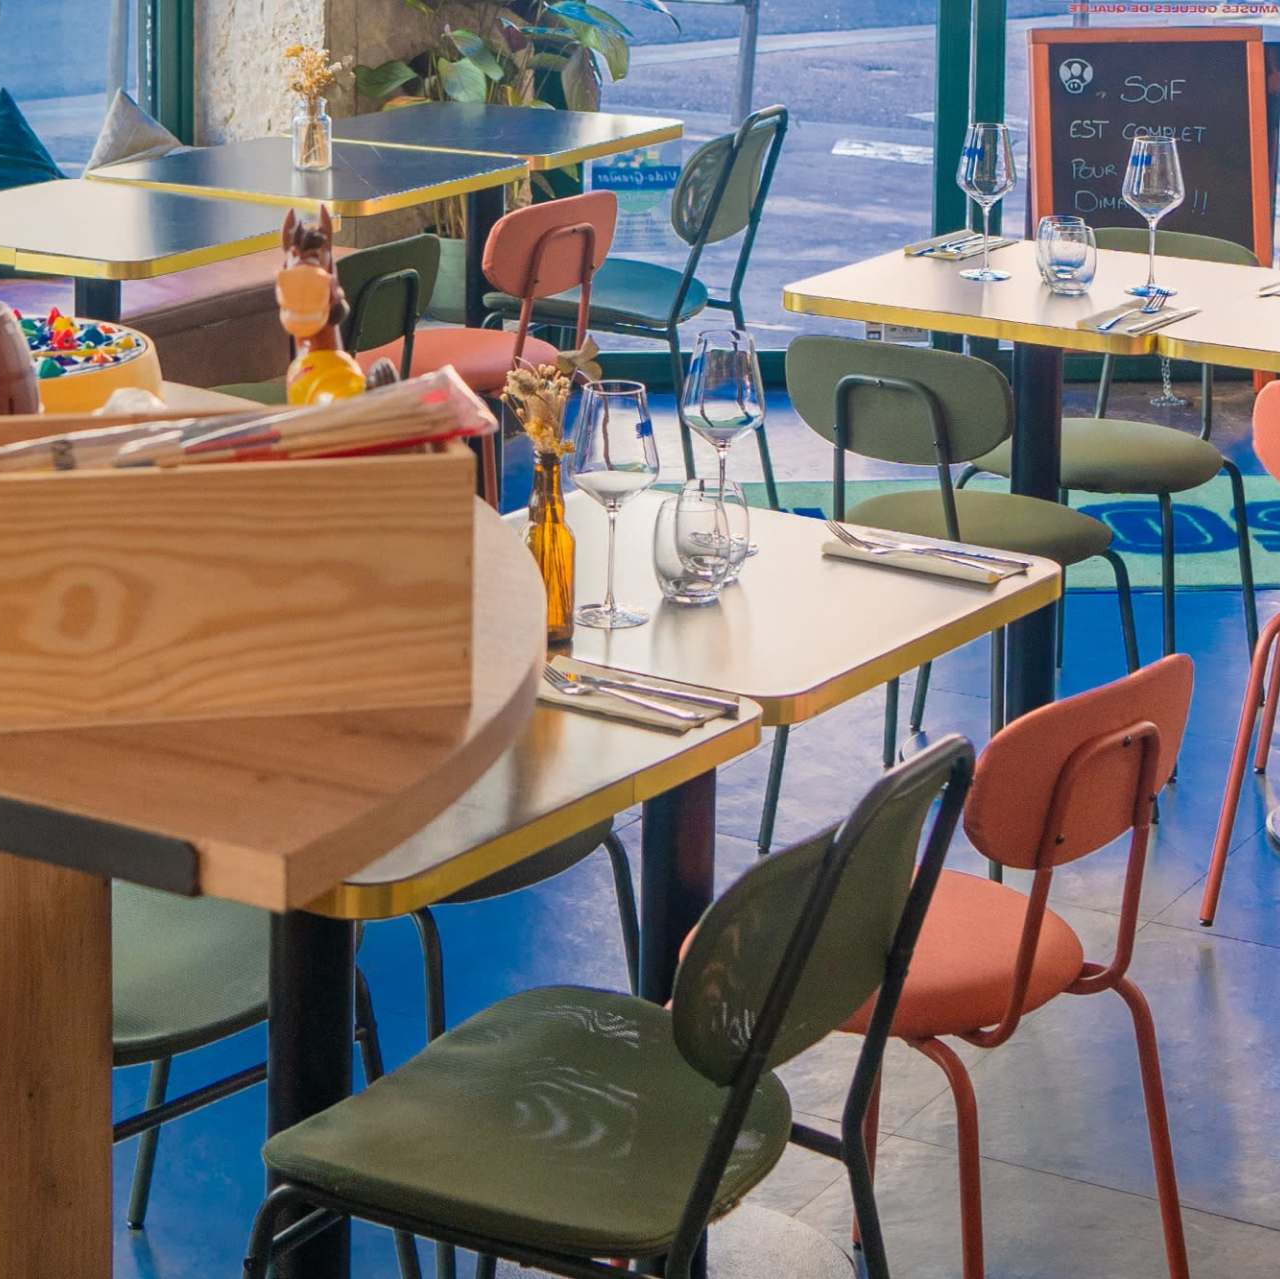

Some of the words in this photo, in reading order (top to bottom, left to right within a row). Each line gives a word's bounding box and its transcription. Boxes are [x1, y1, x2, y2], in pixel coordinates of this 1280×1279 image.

[1120, 76, 1187, 104] SOiF
[1070, 120, 1109, 139] EST
[1071, 158, 1117, 179] POUR
